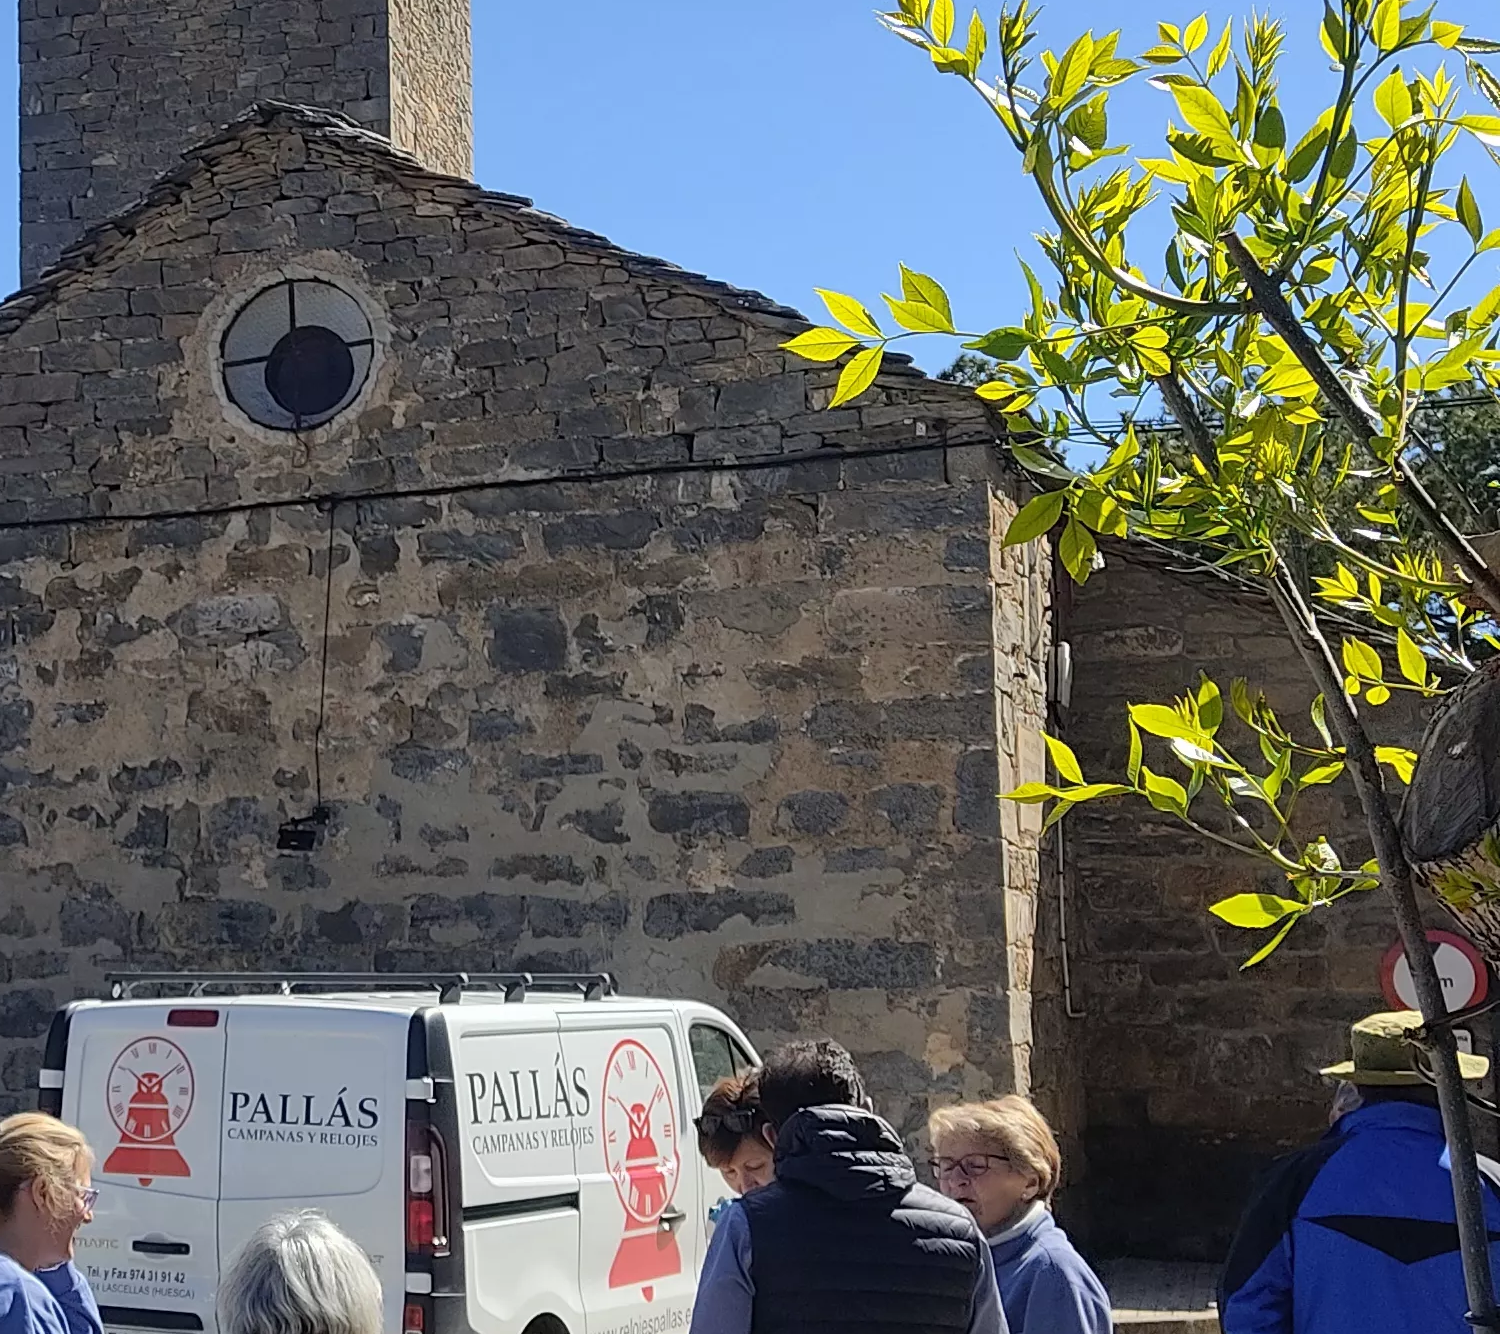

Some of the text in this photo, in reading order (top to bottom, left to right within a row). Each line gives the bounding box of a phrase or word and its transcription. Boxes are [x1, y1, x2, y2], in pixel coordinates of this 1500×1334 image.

[465, 1052, 590, 1125] PALLÁS
[228, 1087, 379, 1129] PALLÁS
[227, 1127, 379, 1149] CAMPANAS Y RELOJES
[472, 1126, 595, 1155] CAMPANAS Y RELOJES
[103, 1269, 110, 1281] y
[111, 1267, 128, 1280] Fax
[129, 1269, 146, 1281] 974
[160, 1271, 171, 1283] 91
[174, 1272, 186, 1284] 42
[101, 1283, 150, 1296] LASCELLAS
[151, 1286, 195, 1300] (HUESCA)
